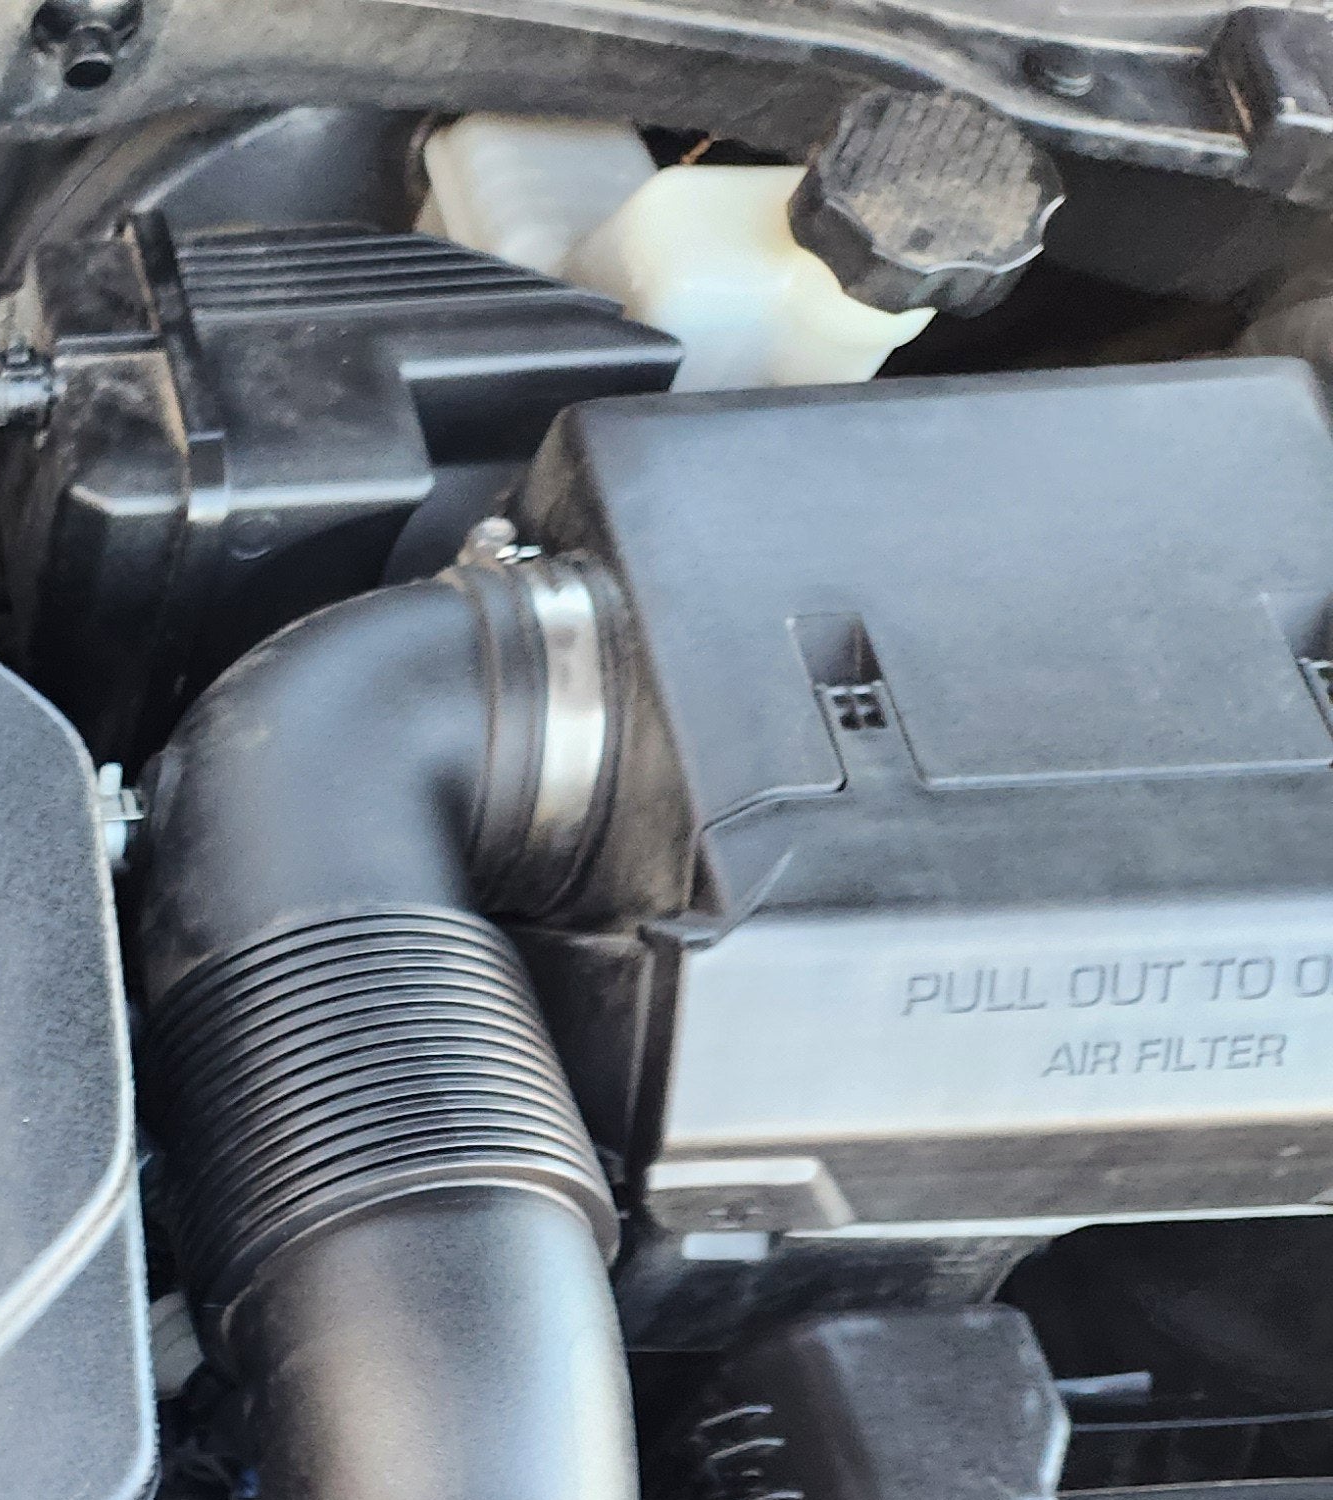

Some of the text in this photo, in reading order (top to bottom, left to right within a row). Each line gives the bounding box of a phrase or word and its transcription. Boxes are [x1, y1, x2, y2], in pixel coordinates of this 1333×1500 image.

[900, 953, 1333, 1016] PULL OUT TO O
[1039, 1032, 1289, 1078] AIR FILTER
